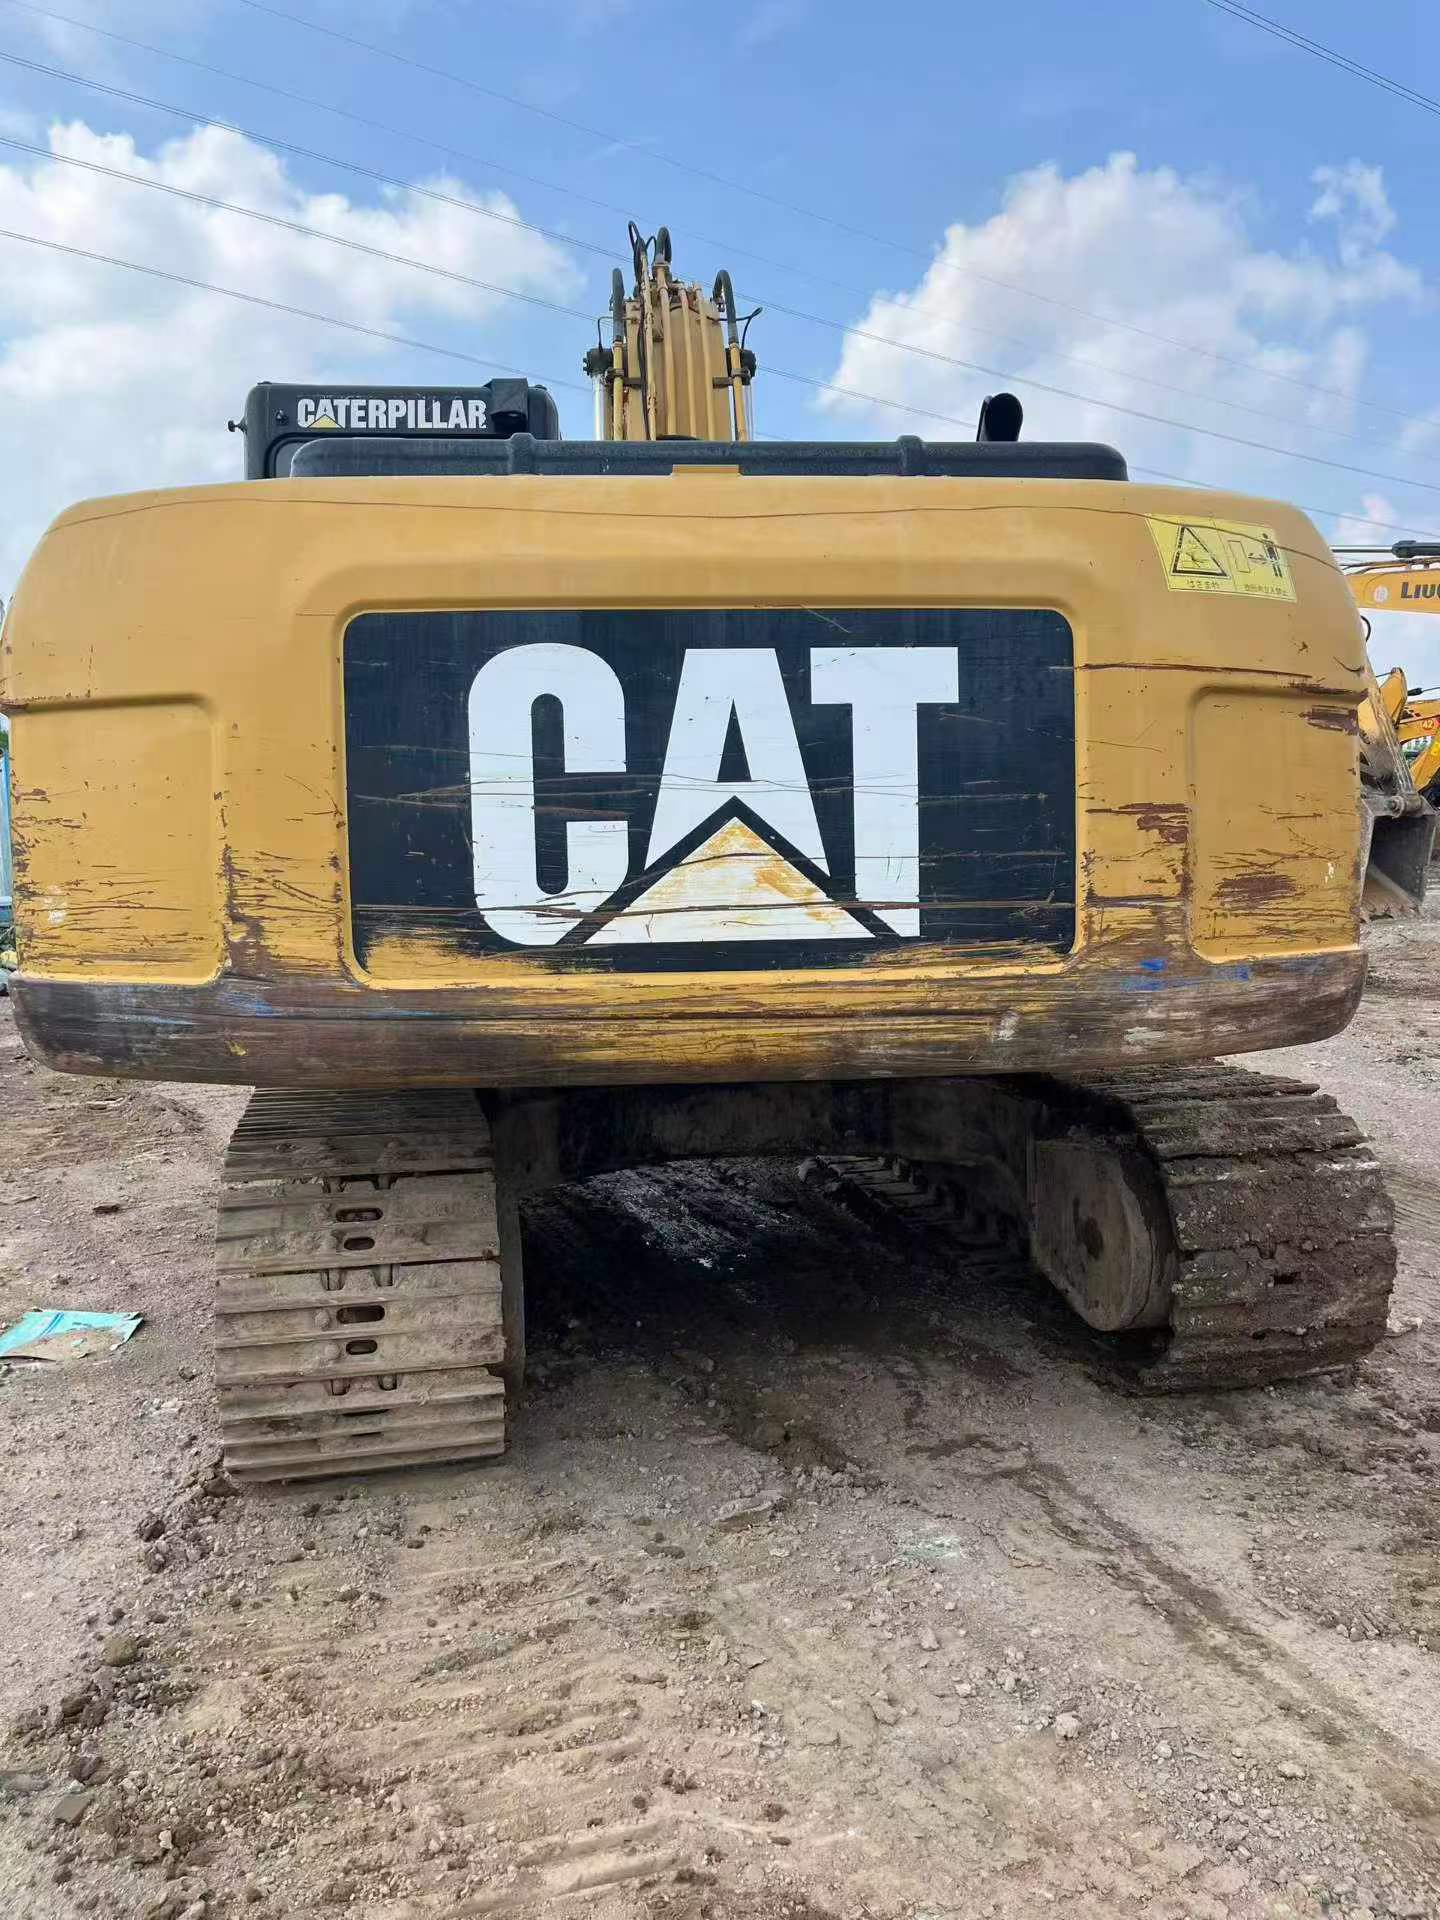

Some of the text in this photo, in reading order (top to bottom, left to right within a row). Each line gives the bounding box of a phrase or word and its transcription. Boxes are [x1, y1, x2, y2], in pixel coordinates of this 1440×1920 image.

[297, 398, 488, 429] CATERPILLAR
[1400, 581, 1440, 599] LIU
[468, 642, 960, 946] CAT
